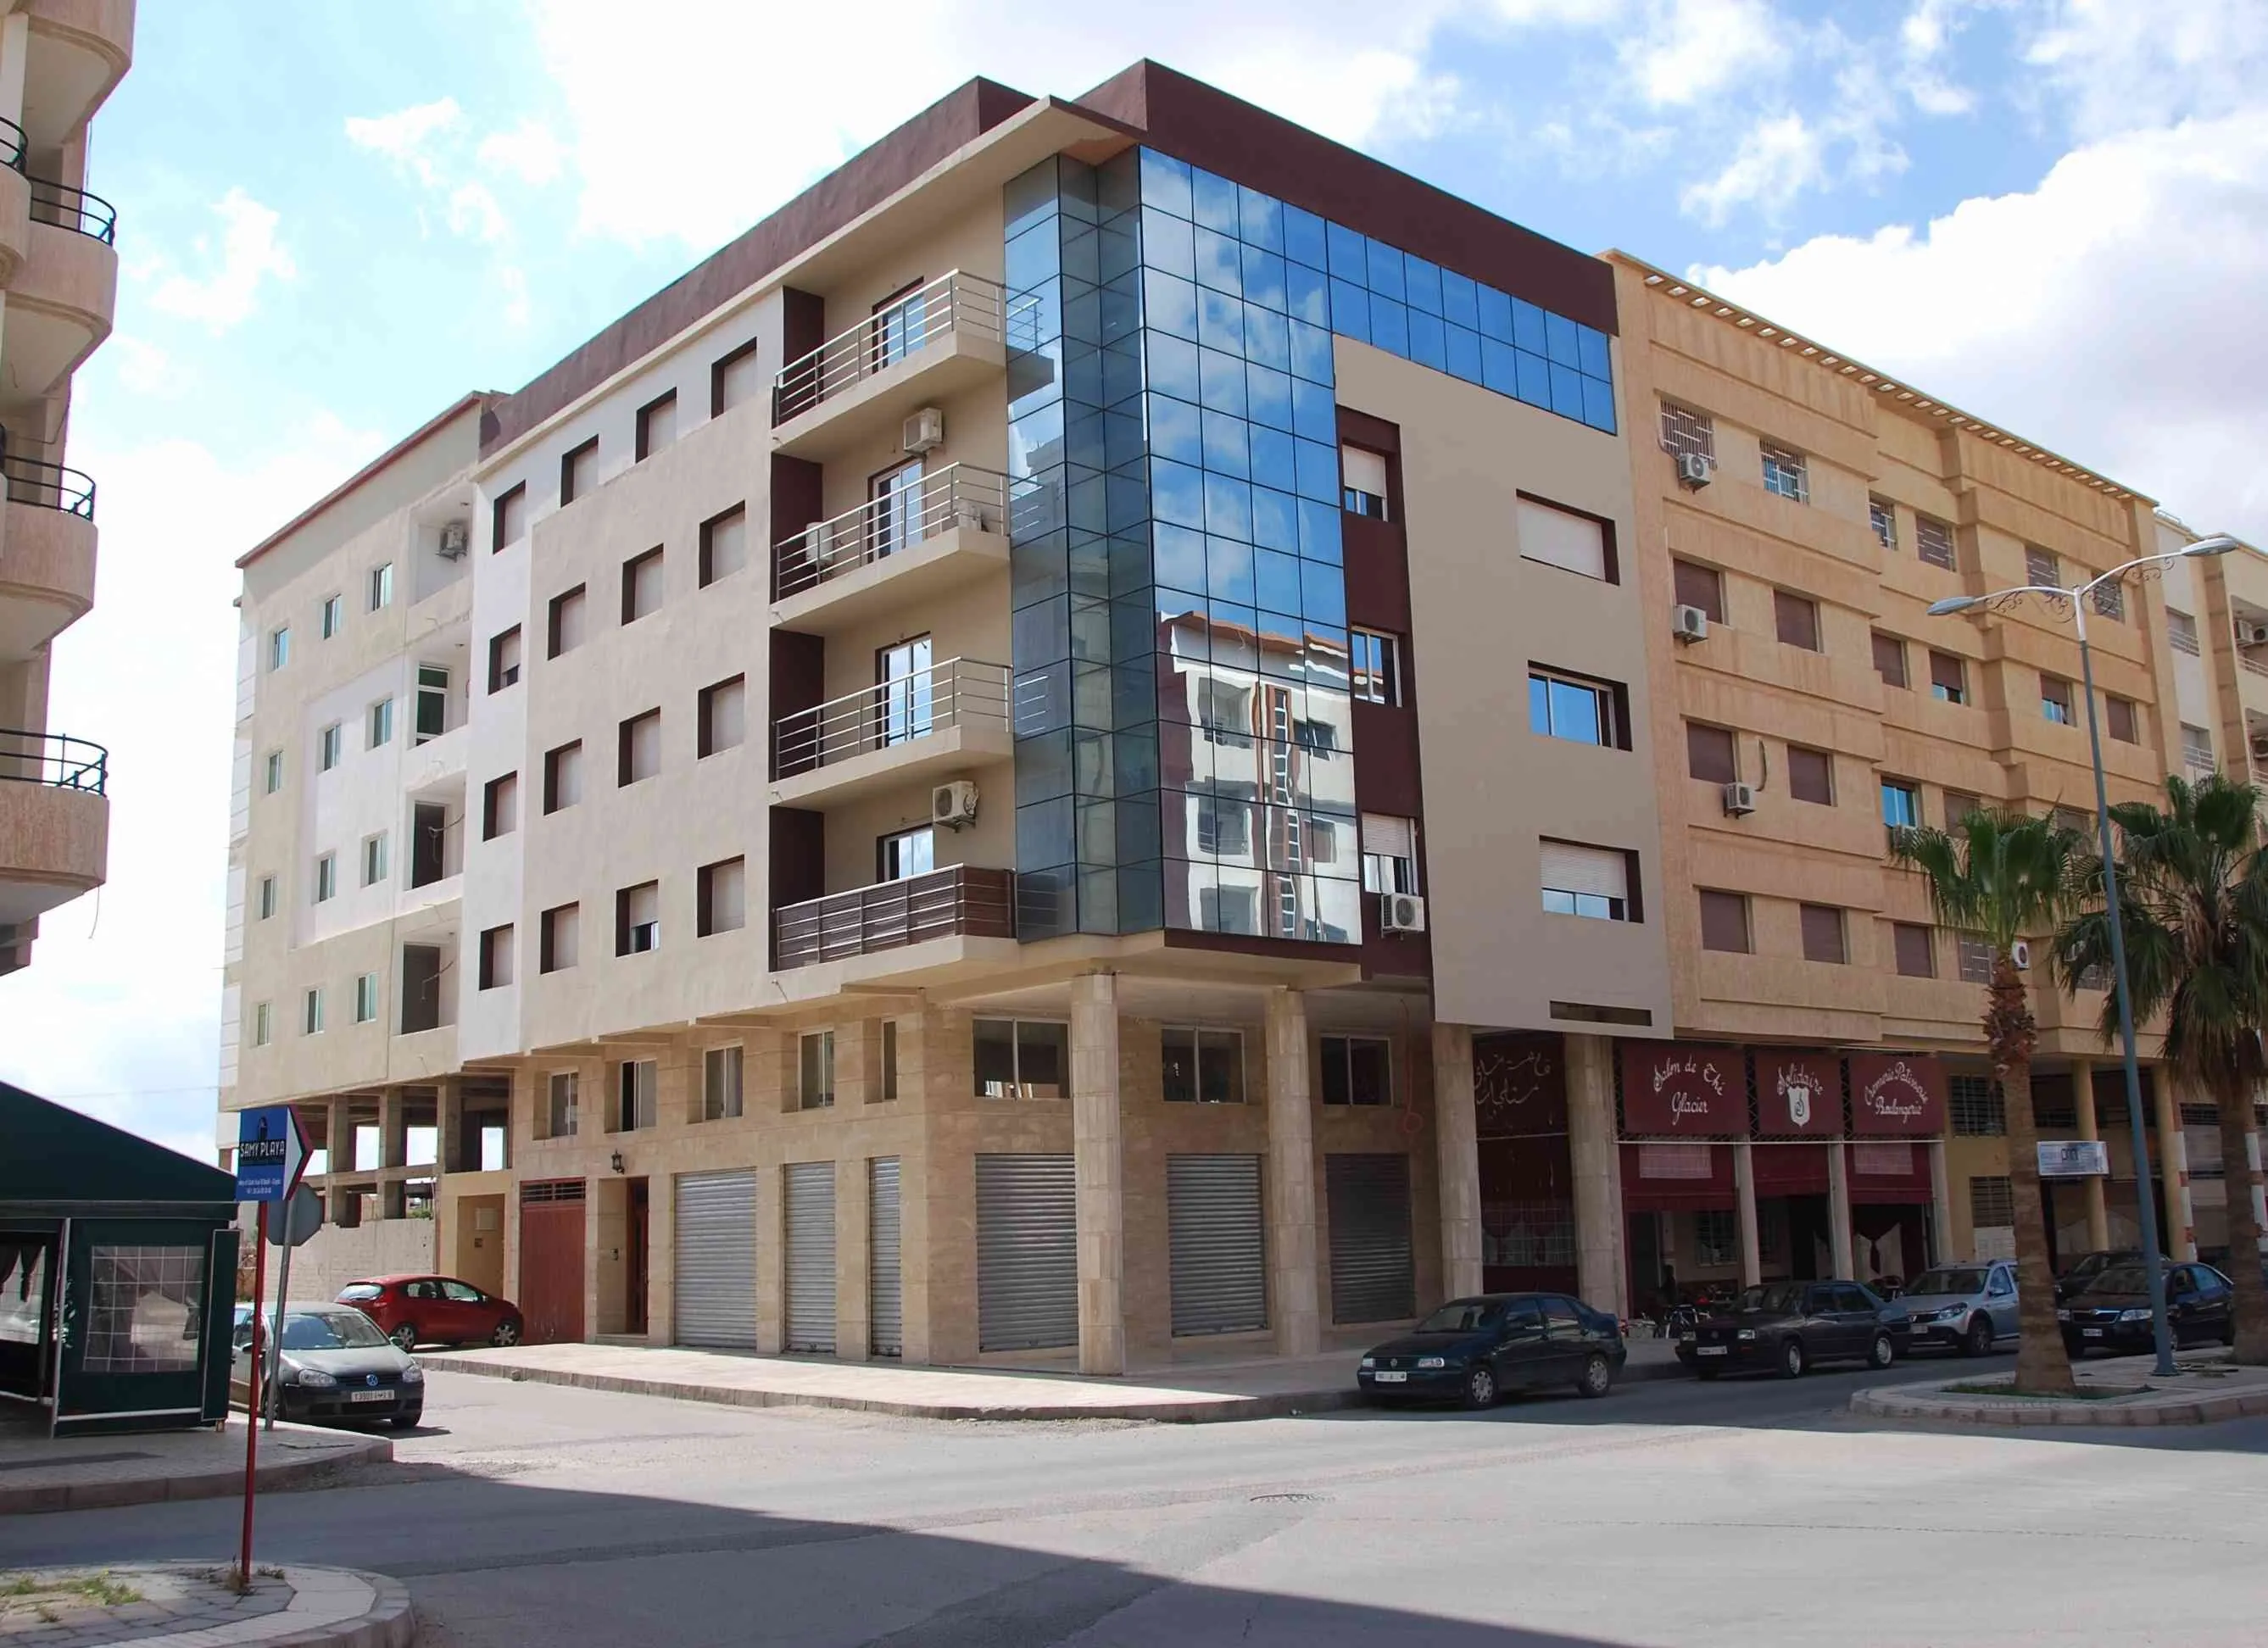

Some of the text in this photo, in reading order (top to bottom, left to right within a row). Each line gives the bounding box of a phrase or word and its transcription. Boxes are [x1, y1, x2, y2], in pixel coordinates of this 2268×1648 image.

[1652, 1057, 1680, 1093] Salon
[1684, 1054, 1697, 1073] de
[1776, 1062, 1823, 1096] Solidaire
[1671, 1091, 1709, 1126] Glacier
[240, 1140, 285, 1158] SAMY PLAYA
